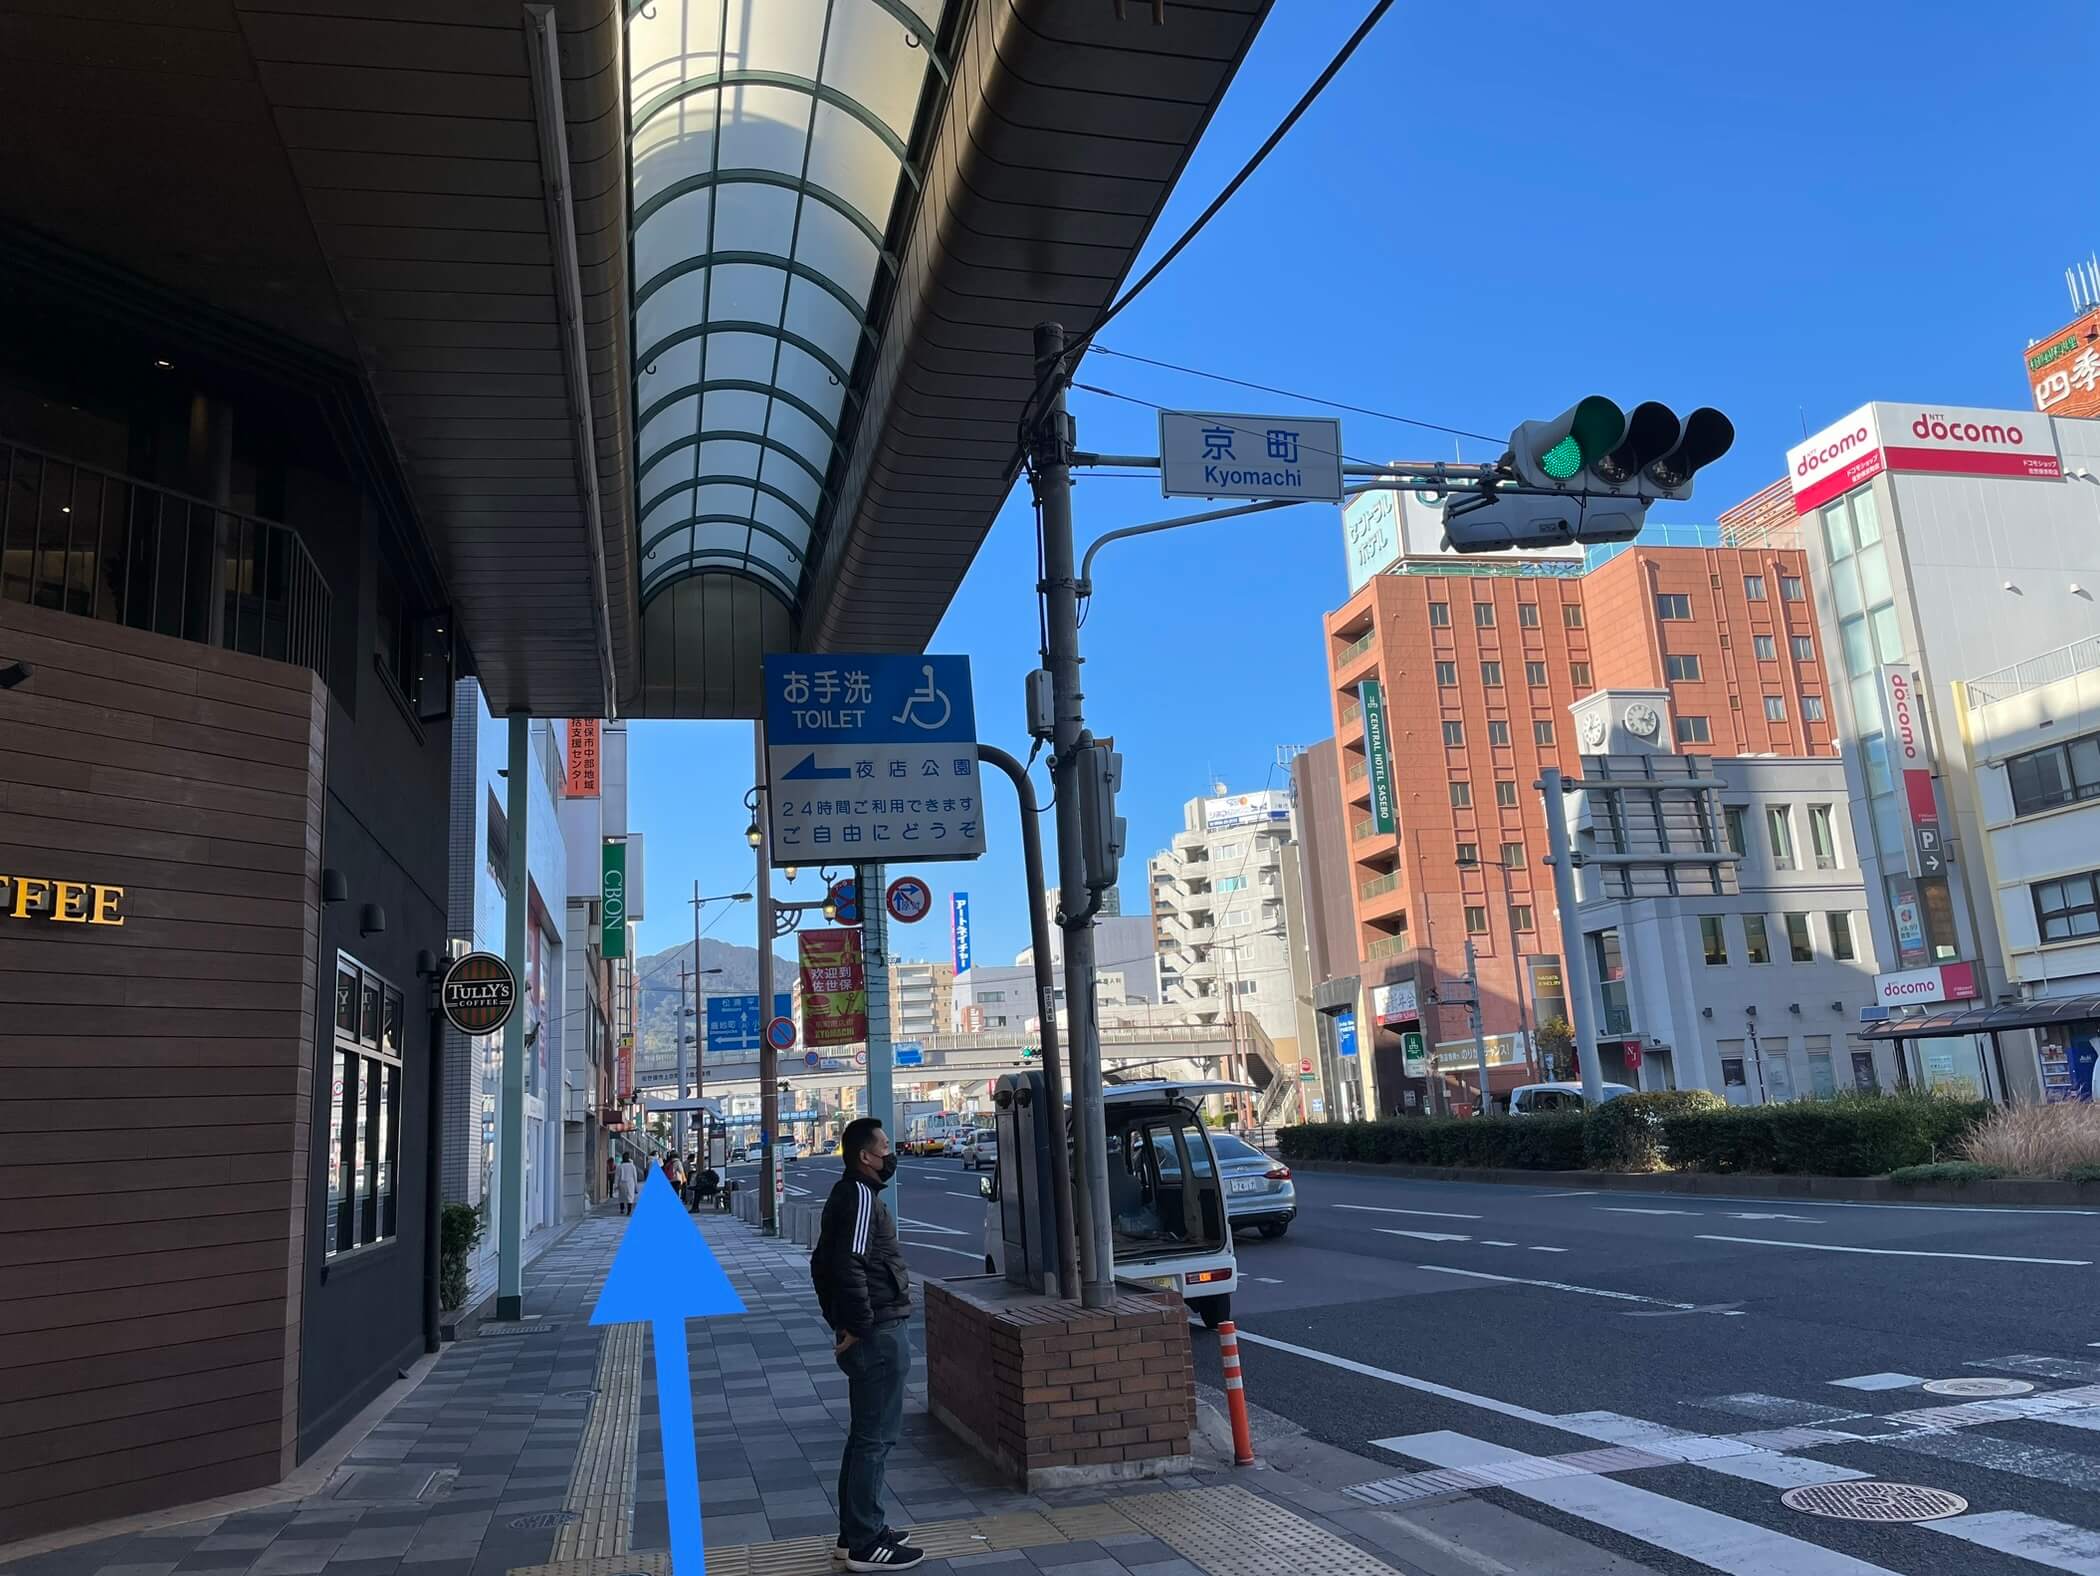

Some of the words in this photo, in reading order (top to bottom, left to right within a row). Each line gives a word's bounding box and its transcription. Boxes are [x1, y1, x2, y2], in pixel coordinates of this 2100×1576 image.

[1929, 413, 1945, 421] NTT
[1912, 413, 2023, 445] docomo
[1201, 426, 1300, 463] 京町
[1797, 427, 1867, 477] docomo
[1204, 465, 1301, 487] Kyomachi
[783, 670, 872, 705] お手洗
[792, 710, 866, 729] TOILET
[1891, 674, 1916, 759] docomo
[1370, 712, 1381, 752] CENTRAL
[856, 758, 972, 778] 夜店公園
[1374, 753, 1385, 782] HOTEL
[783, 797, 973, 817] 24時間ご利用できます
[1378, 784, 1389, 819] SASEBO
[783, 820, 976, 844] ご自由にどうぞ
[1922, 831, 1935, 849] P
[0, 874, 125, 926] FEE
[956, 899, 969, 968] アートネイチャー
[811, 966, 852, 980] 欢迎到
[448, 983, 510, 1000] TULLY'S
[812, 979, 853, 993] 佐世保
[1884, 981, 1935, 996] docomo
[459, 999, 498, 1007] COFFEE
